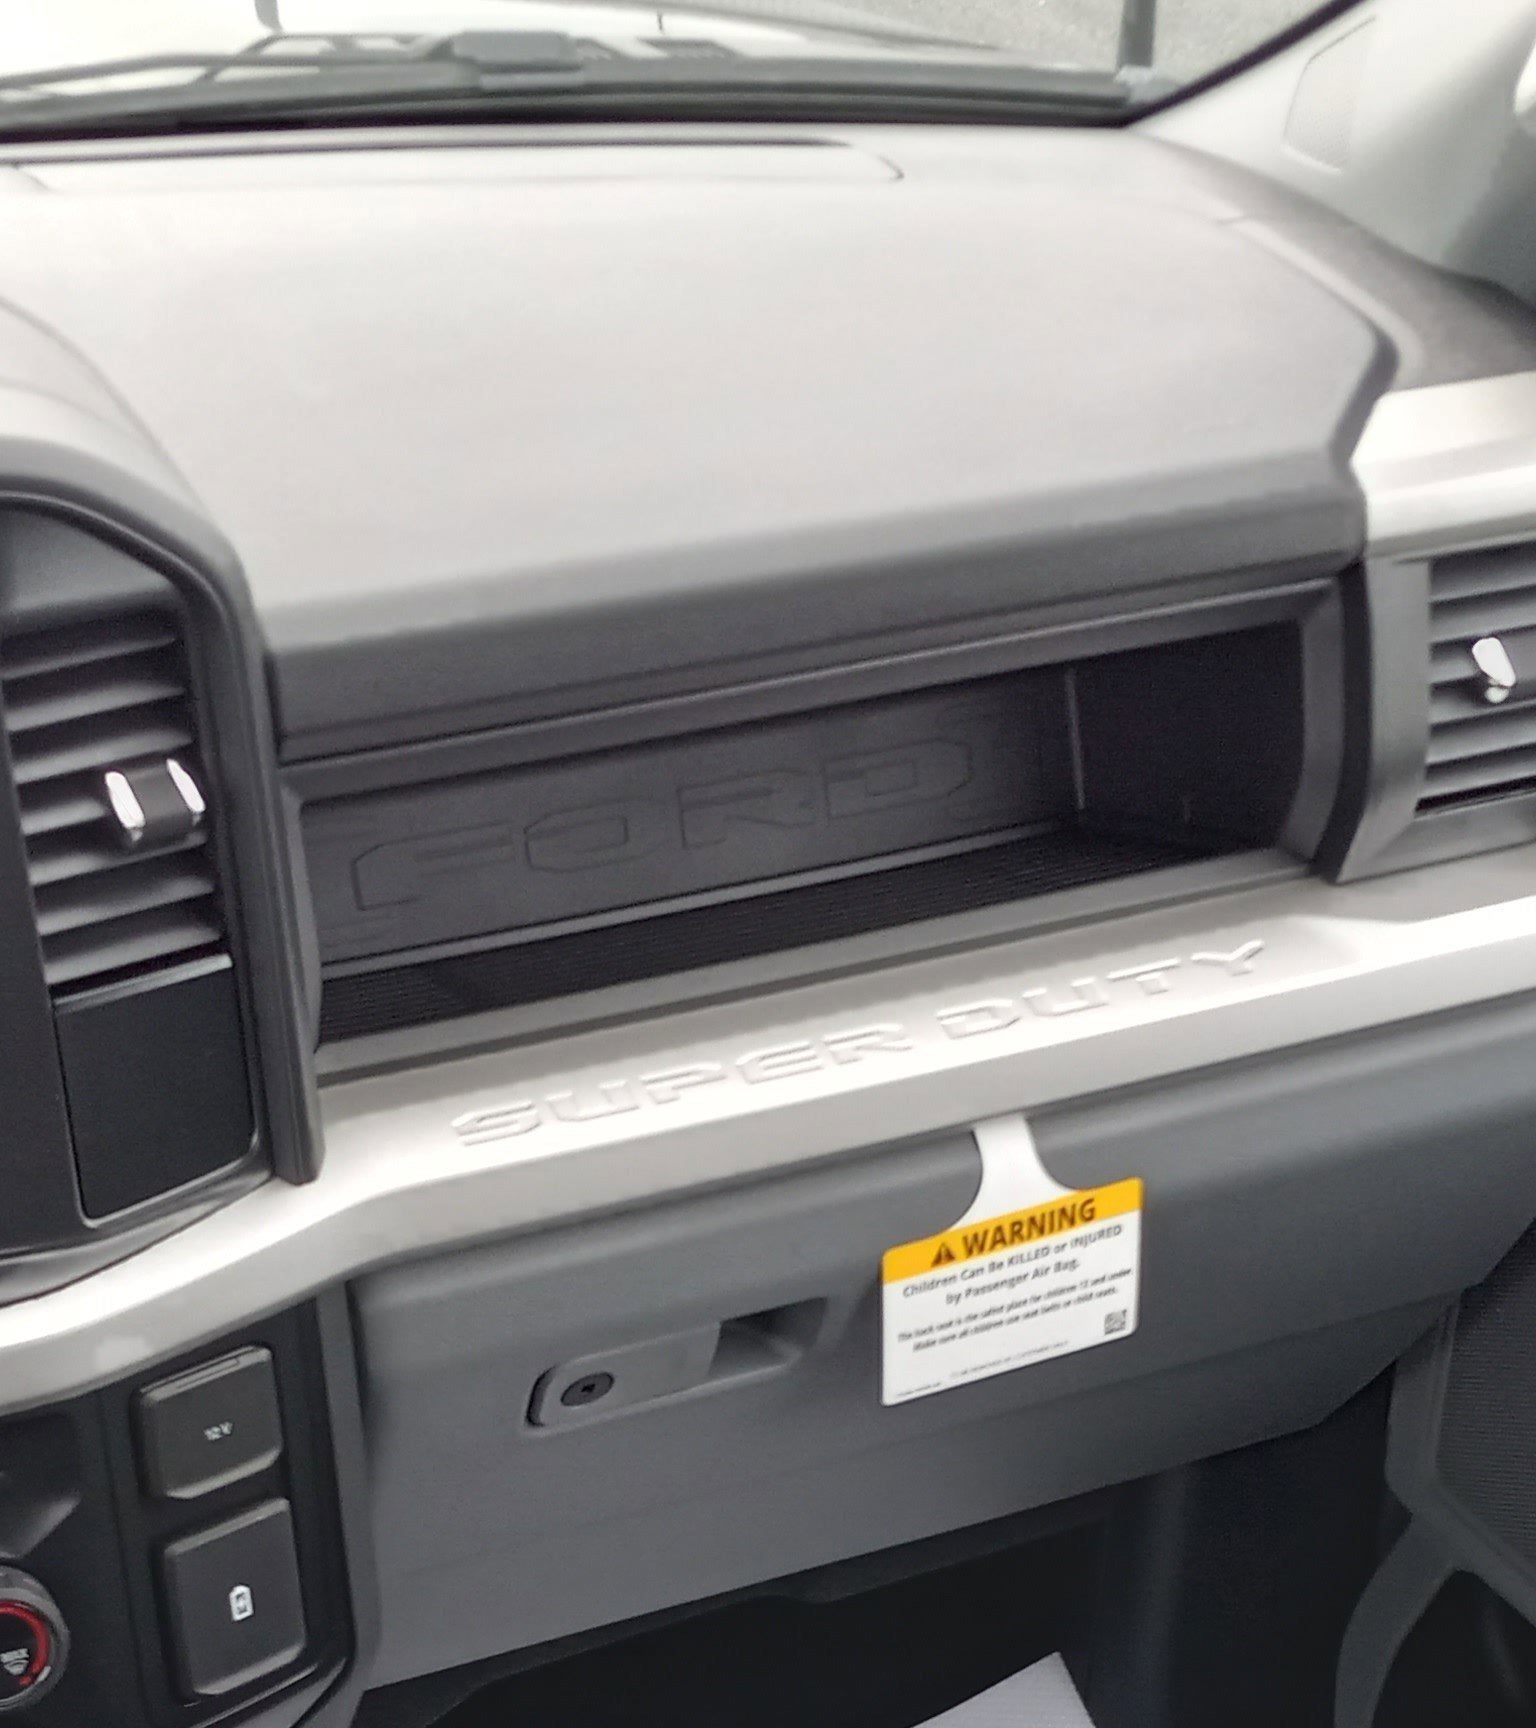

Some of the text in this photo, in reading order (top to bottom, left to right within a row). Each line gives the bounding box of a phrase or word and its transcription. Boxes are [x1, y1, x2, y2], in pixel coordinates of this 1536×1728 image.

[349, 736, 974, 912] FORD
[450, 939, 1264, 1146] SUPER DUTY
[902, 1224, 1123, 1298] Children Can Be KILLED or INJURED
[961, 1198, 1097, 1259] WARNING
[945, 1294, 962, 1306] by
[964, 1273, 1030, 1299] Passenger
[1031, 1265, 1049, 1280] Air
